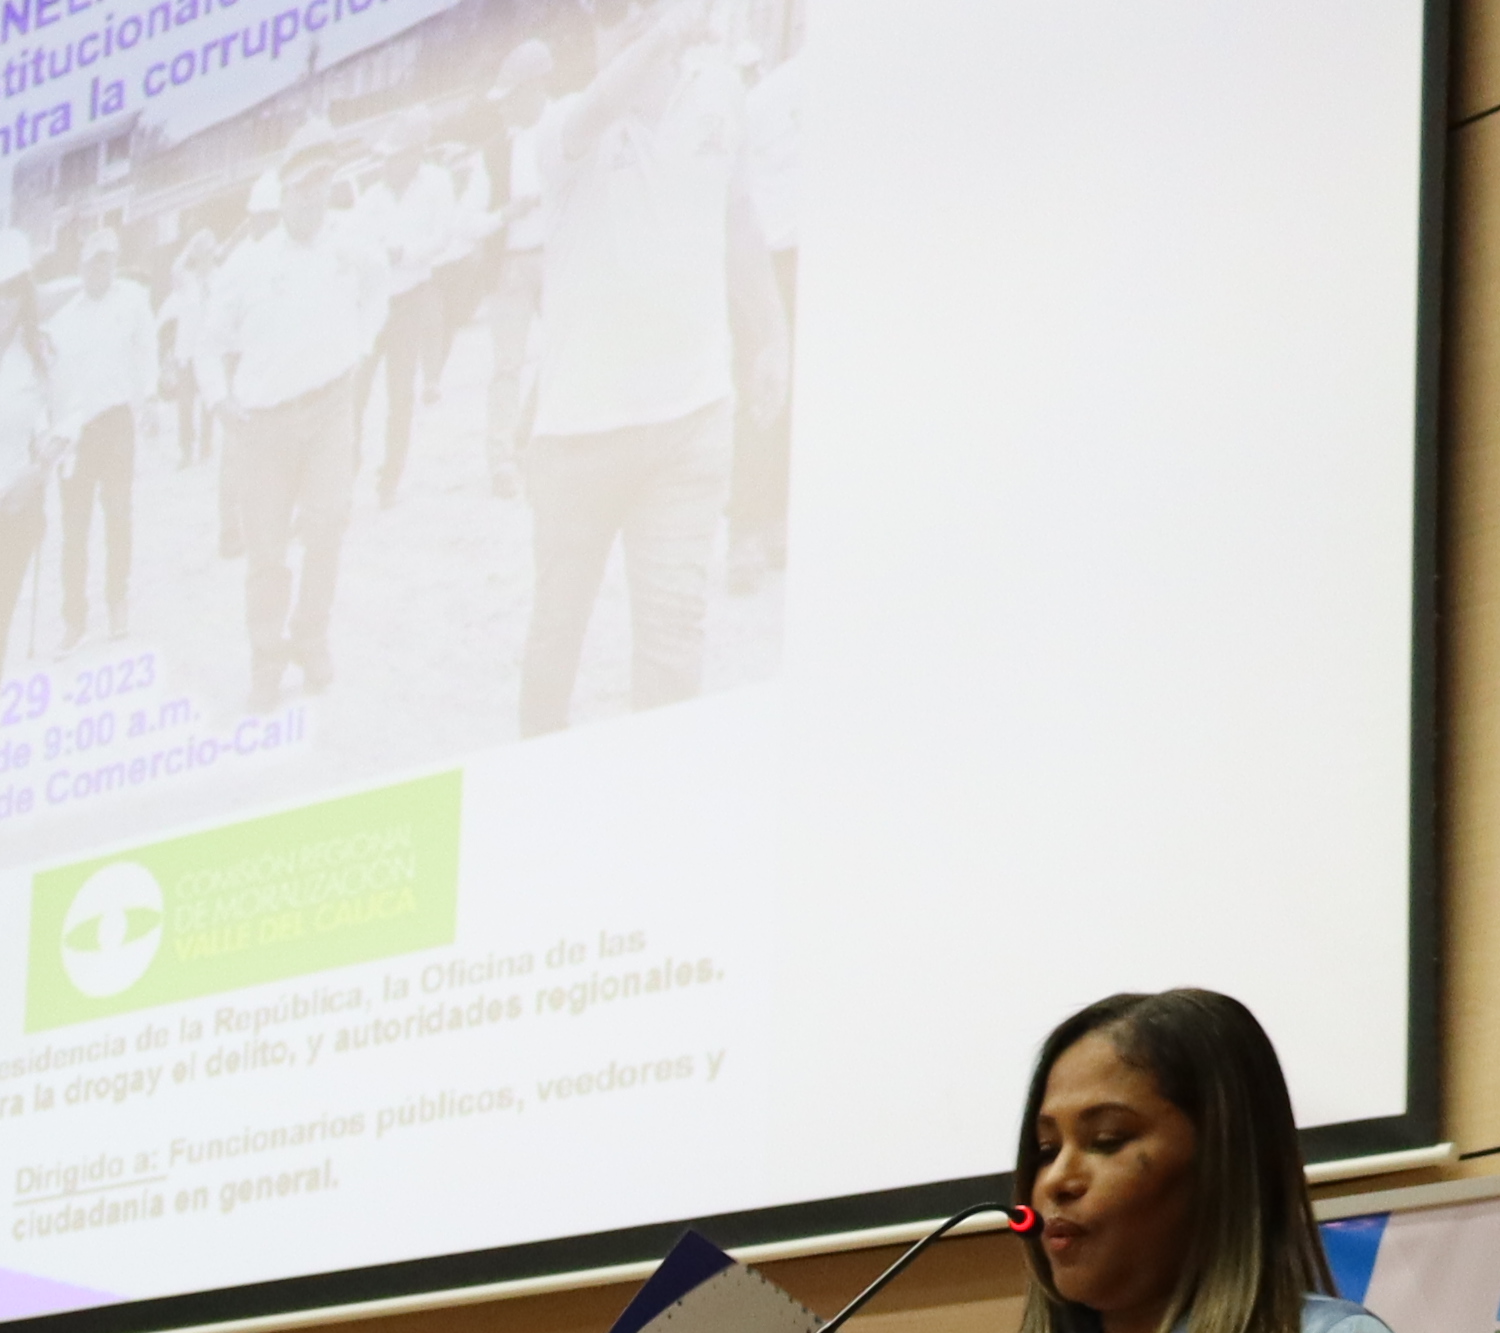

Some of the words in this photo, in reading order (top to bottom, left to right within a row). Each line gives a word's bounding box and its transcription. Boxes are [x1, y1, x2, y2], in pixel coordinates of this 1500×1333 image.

[88, 75, 126, 122] la
[0, 672, 52, 728] 29
[61, 652, 158, 706] -2023
[42, 710, 117, 762] 9:00
[125, 696, 202, 738] a.m.
[135, 1022, 170, 1052] de
[179, 1016, 204, 1044] la
[382, 973, 411, 1003] la
[420, 950, 535, 996] Oficina
[545, 937, 588, 970] de
[597, 926, 648, 960] las
[33, 1083, 56, 1112] la
[171, 1053, 197, 1083] el
[204, 1037, 296, 1080] delito,
[306, 1031, 325, 1067] y
[333, 991, 523, 1055] autoridades
[535, 955, 726, 1017] regionales.
[14, 1151, 124, 1198] Dirigido
[132, 1148, 161, 1176] a:
[167, 1109, 367, 1169] Funcionarios
[375, 1082, 526, 1139] públicos,
[535, 1051, 695, 1104] veedores
[705, 1046, 727, 1081] y
[173, 1182, 209, 1215] en
[218, 1157, 341, 1214] general.
